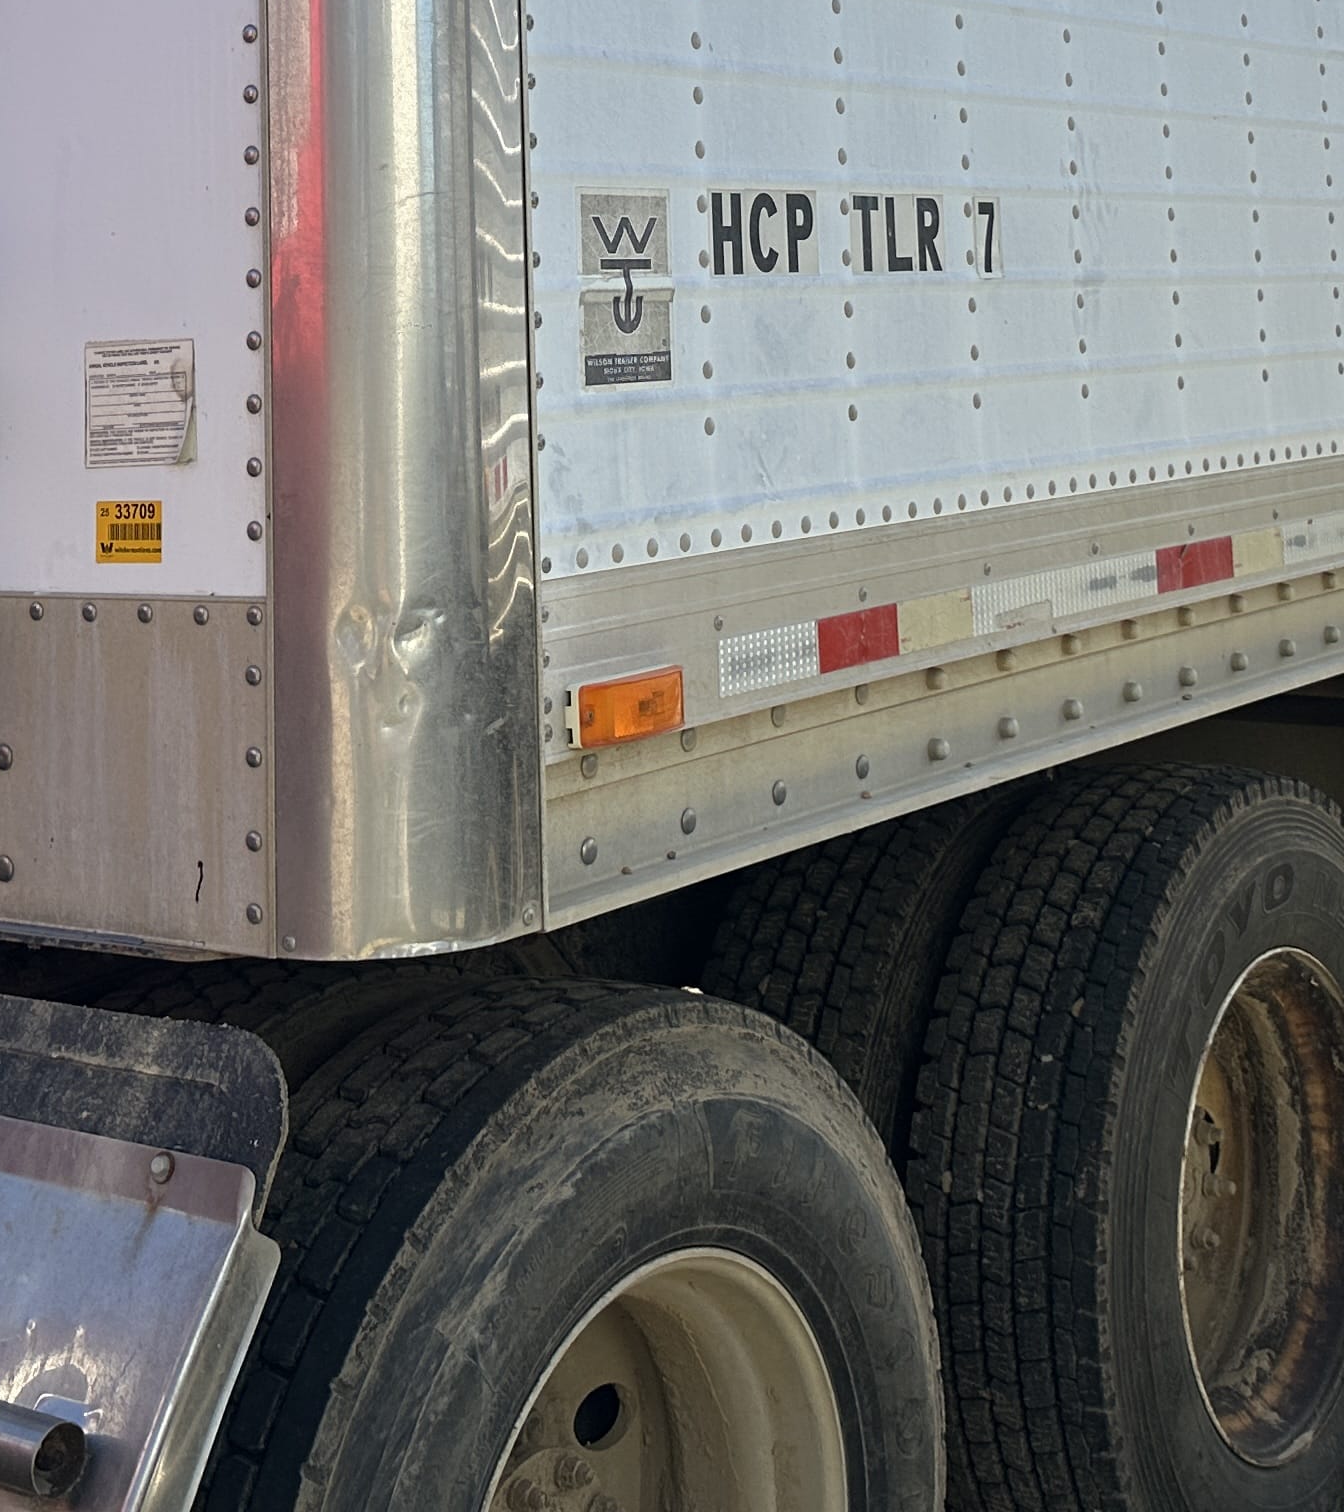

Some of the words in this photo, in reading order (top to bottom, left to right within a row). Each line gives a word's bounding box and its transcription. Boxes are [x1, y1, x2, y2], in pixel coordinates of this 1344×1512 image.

[711, 192, 814, 275] HCP
[852, 194, 943, 273] TLR
[977, 202, 995, 273] 7
[114, 503, 156, 520] 33709
